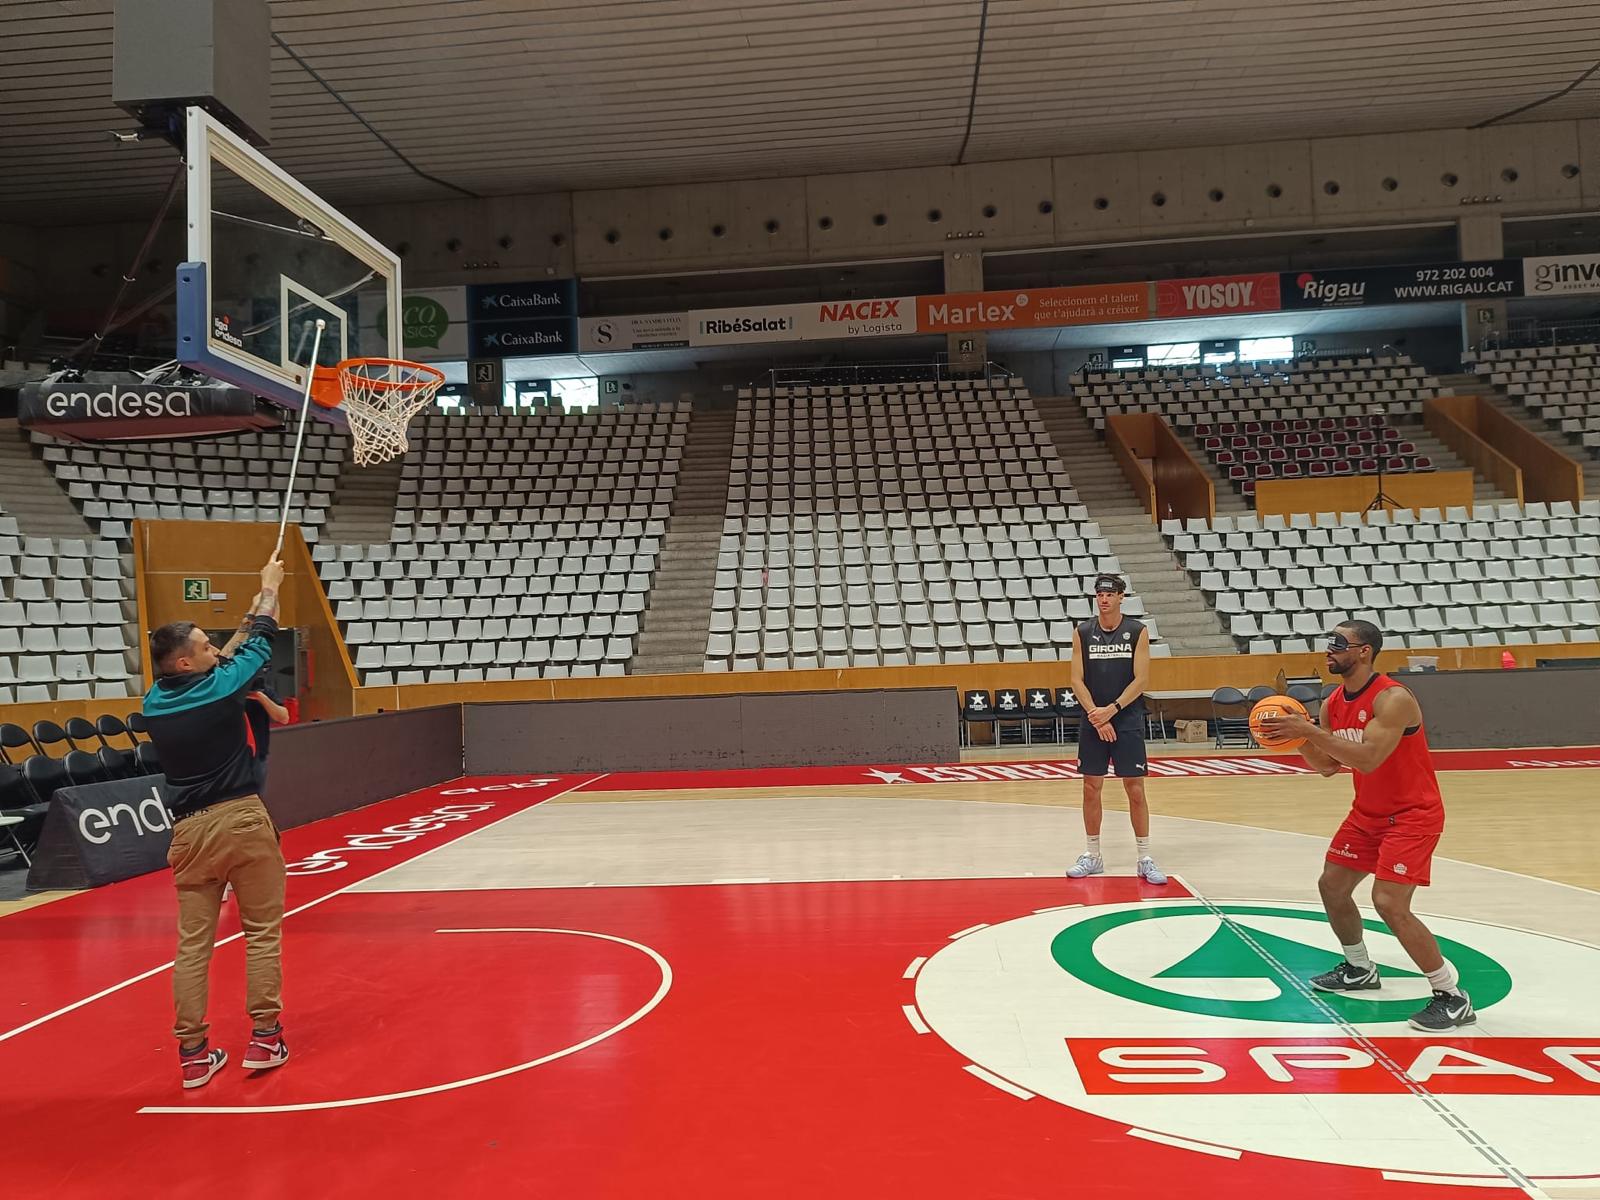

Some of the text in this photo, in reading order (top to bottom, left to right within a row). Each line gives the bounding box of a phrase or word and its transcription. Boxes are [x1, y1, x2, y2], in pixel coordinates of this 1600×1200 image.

[1416, 266, 1494, 281] 972 202 004
[1182, 281, 1254, 310] YOSOY
[1303, 280, 1366, 302] Rigau
[1394, 280, 1514, 298] WWW.RIGAU.CAT
[500, 292, 561, 308] CaixaBank
[1040, 293, 1139, 308] Seleccionem el talent
[819, 299, 900, 322] NACEX
[928, 301, 1015, 325] Marlex
[1034, 311, 1051, 320] que
[706, 317, 787, 334] RibéSalat
[847, 322, 902, 335] by Logista
[501, 330, 563, 346] CaixaBank
[46, 385, 191, 417] endesa
[1089, 643, 1132, 652] GIRONA
[907, 763, 1116, 782] ESTREL
[79, 786, 175, 844] end
